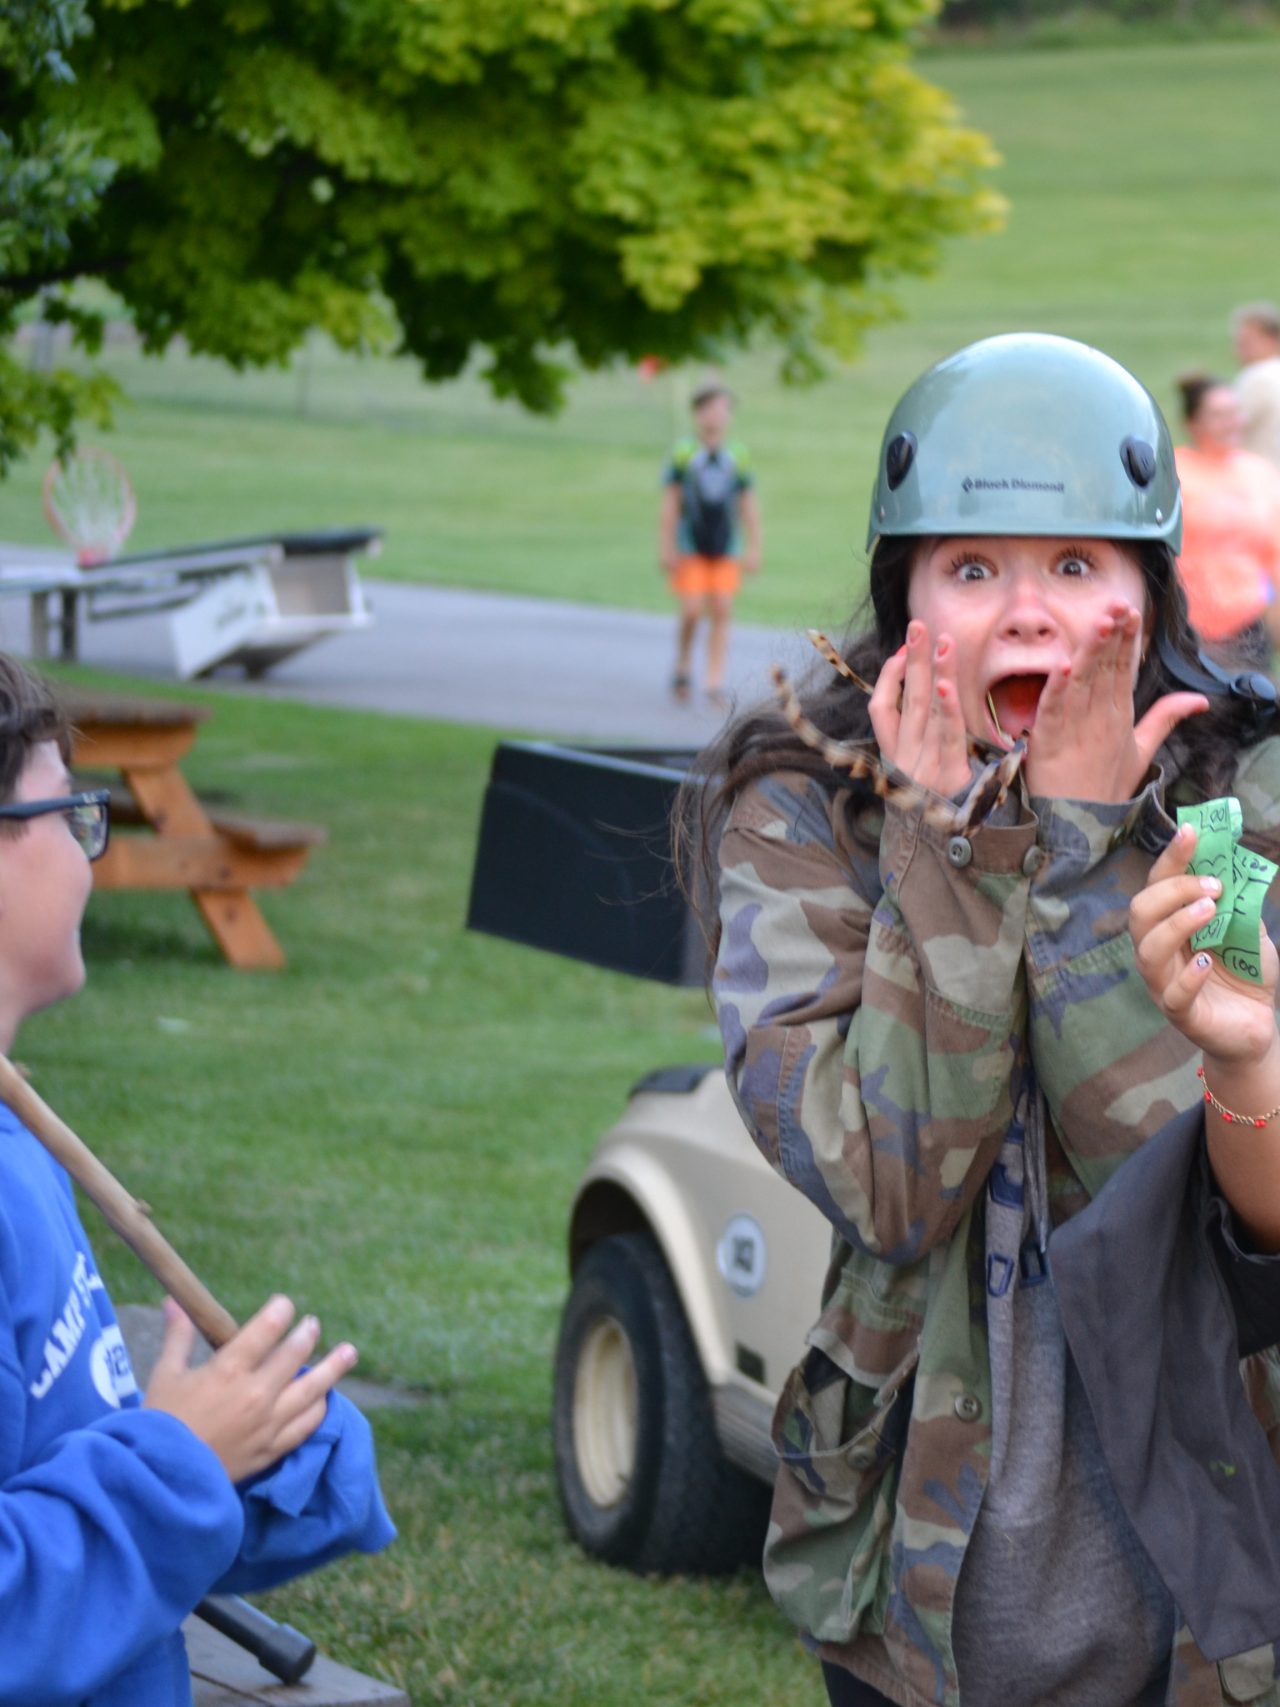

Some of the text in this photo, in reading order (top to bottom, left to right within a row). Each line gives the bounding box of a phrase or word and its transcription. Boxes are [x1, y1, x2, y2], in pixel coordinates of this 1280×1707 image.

[975, 478, 1065, 493] Block Diamond
[1232, 954, 1260, 978] 100
